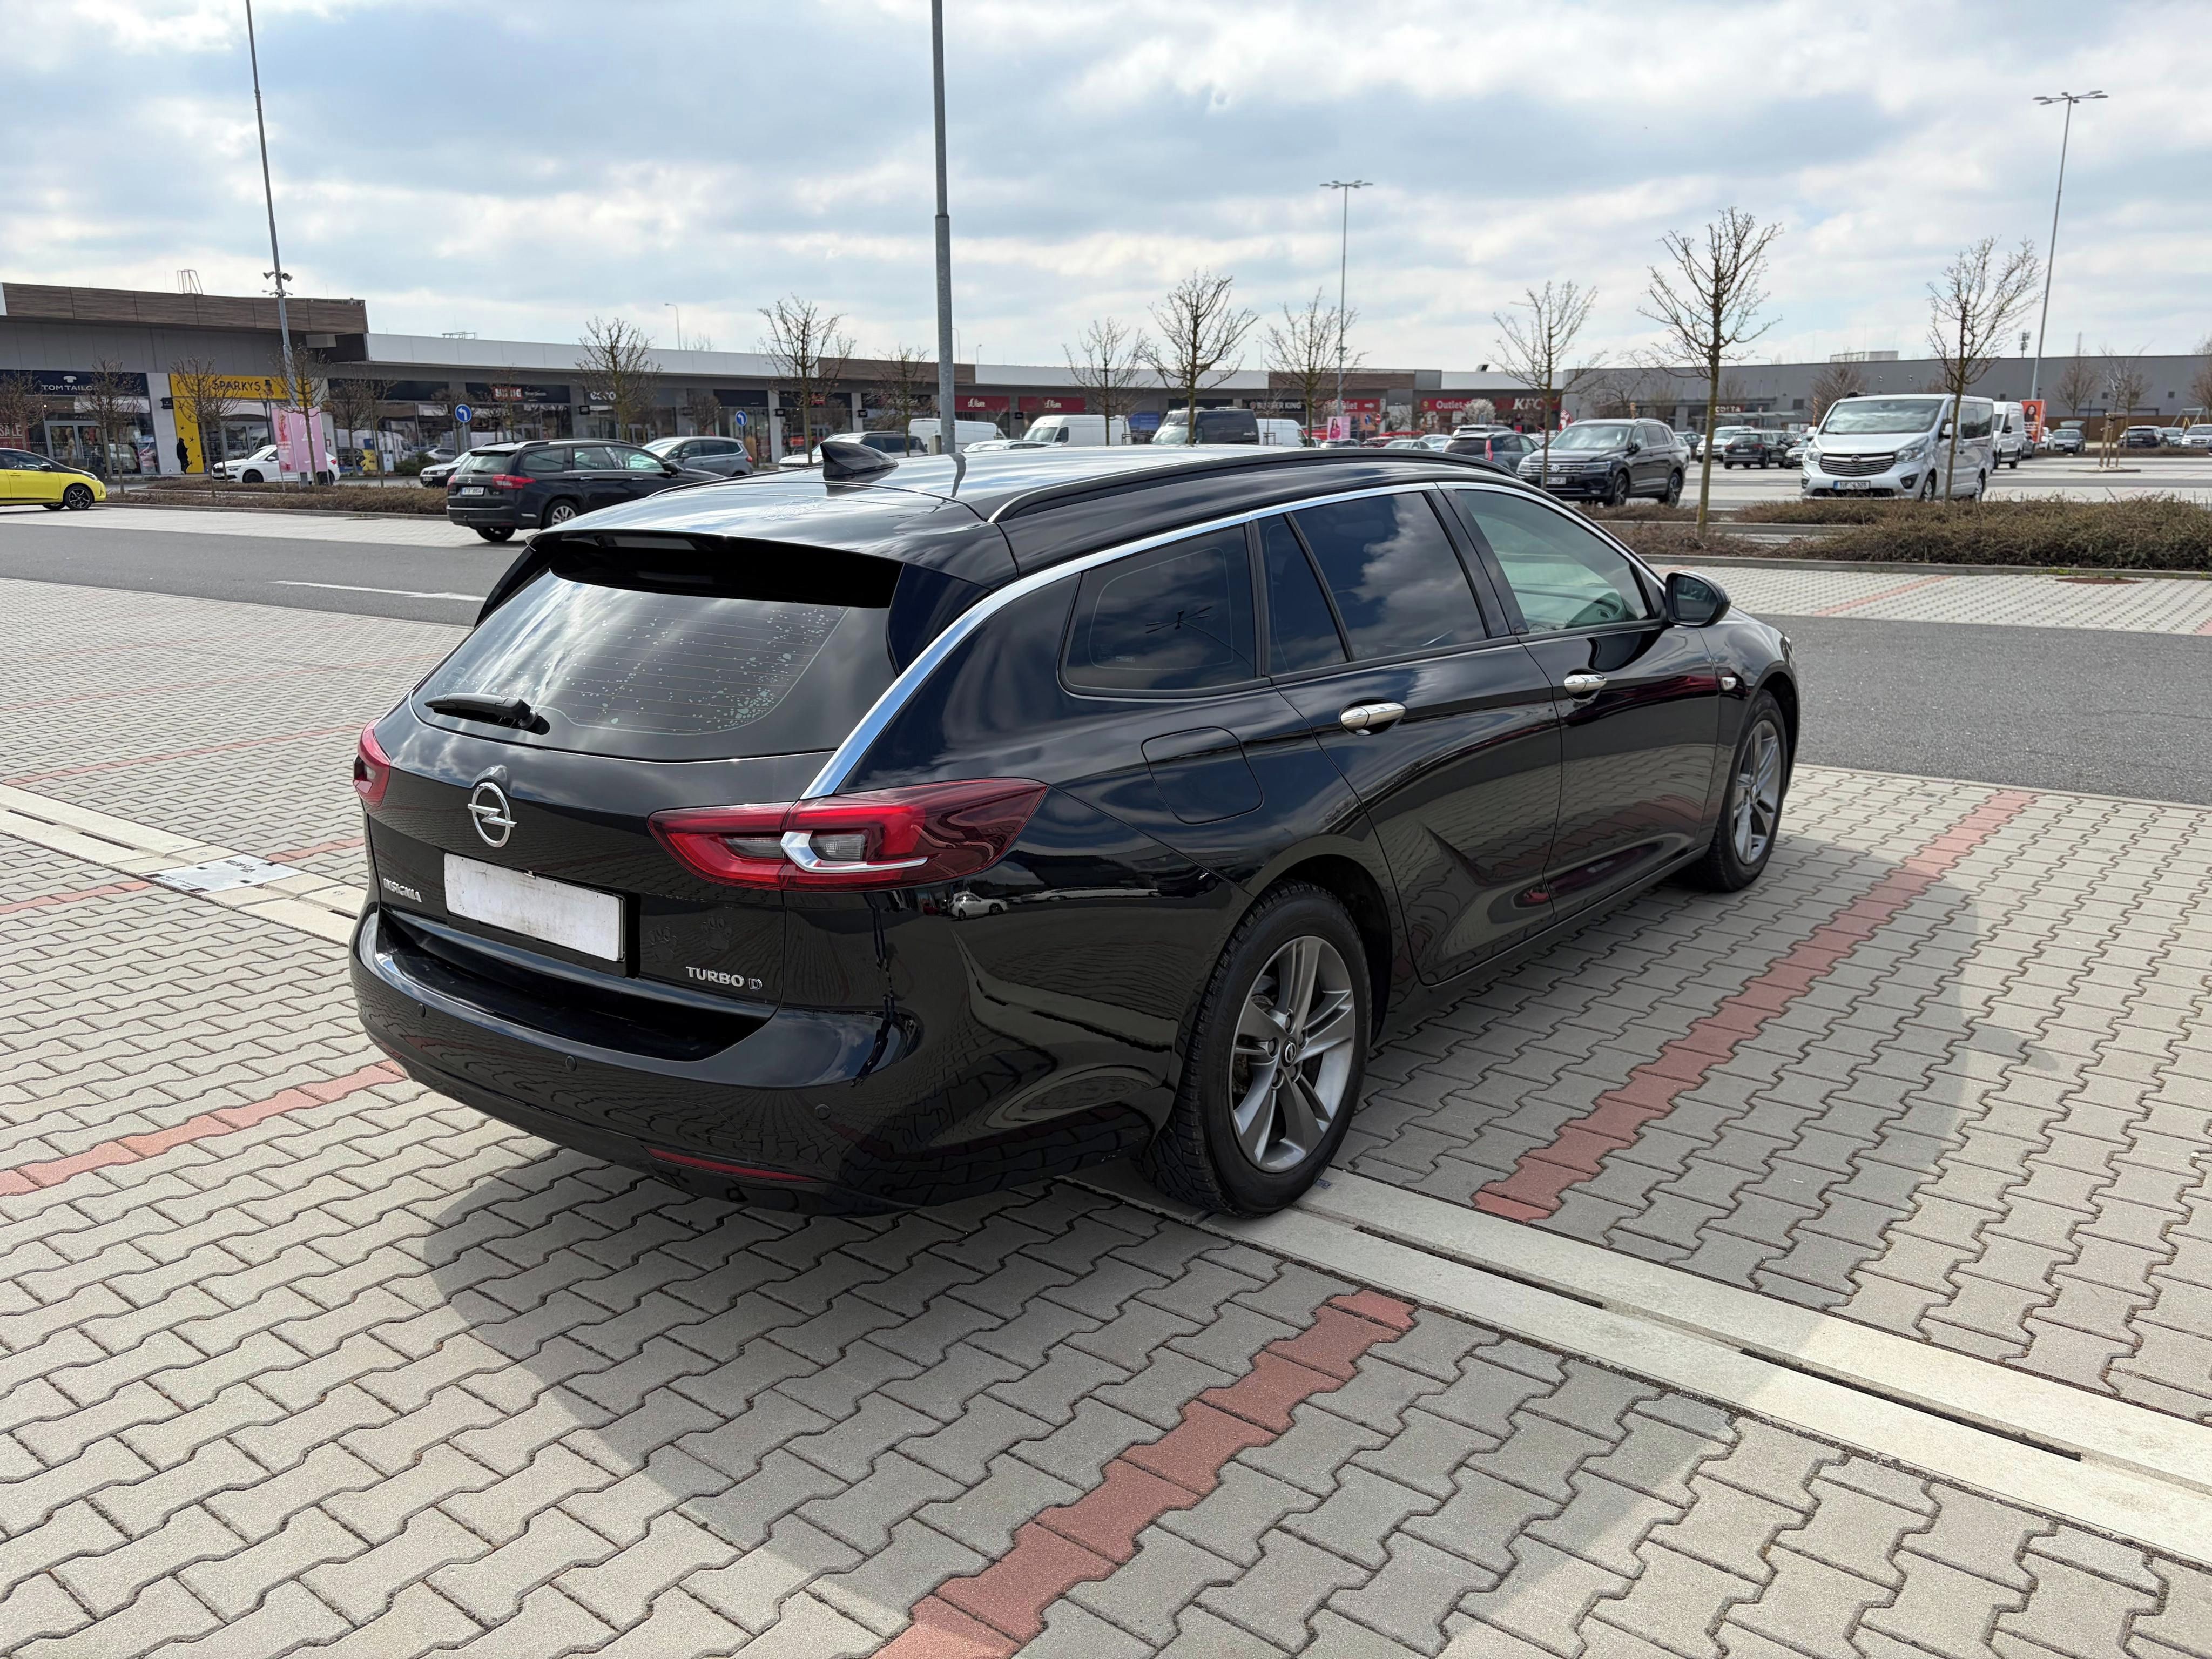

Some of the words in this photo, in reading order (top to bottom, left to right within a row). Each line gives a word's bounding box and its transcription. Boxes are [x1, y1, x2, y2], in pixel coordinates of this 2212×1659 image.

[212, 380, 261, 391] SPARKYS
[1436, 400, 1462, 409] Outlet
[1512, 397, 1542, 410] KFC
[0, 424, 22, 437] SALE
[383, 878, 422, 903] INSIGNIA
[685, 966, 745, 988] TURBO
[748, 977, 763, 990] D
